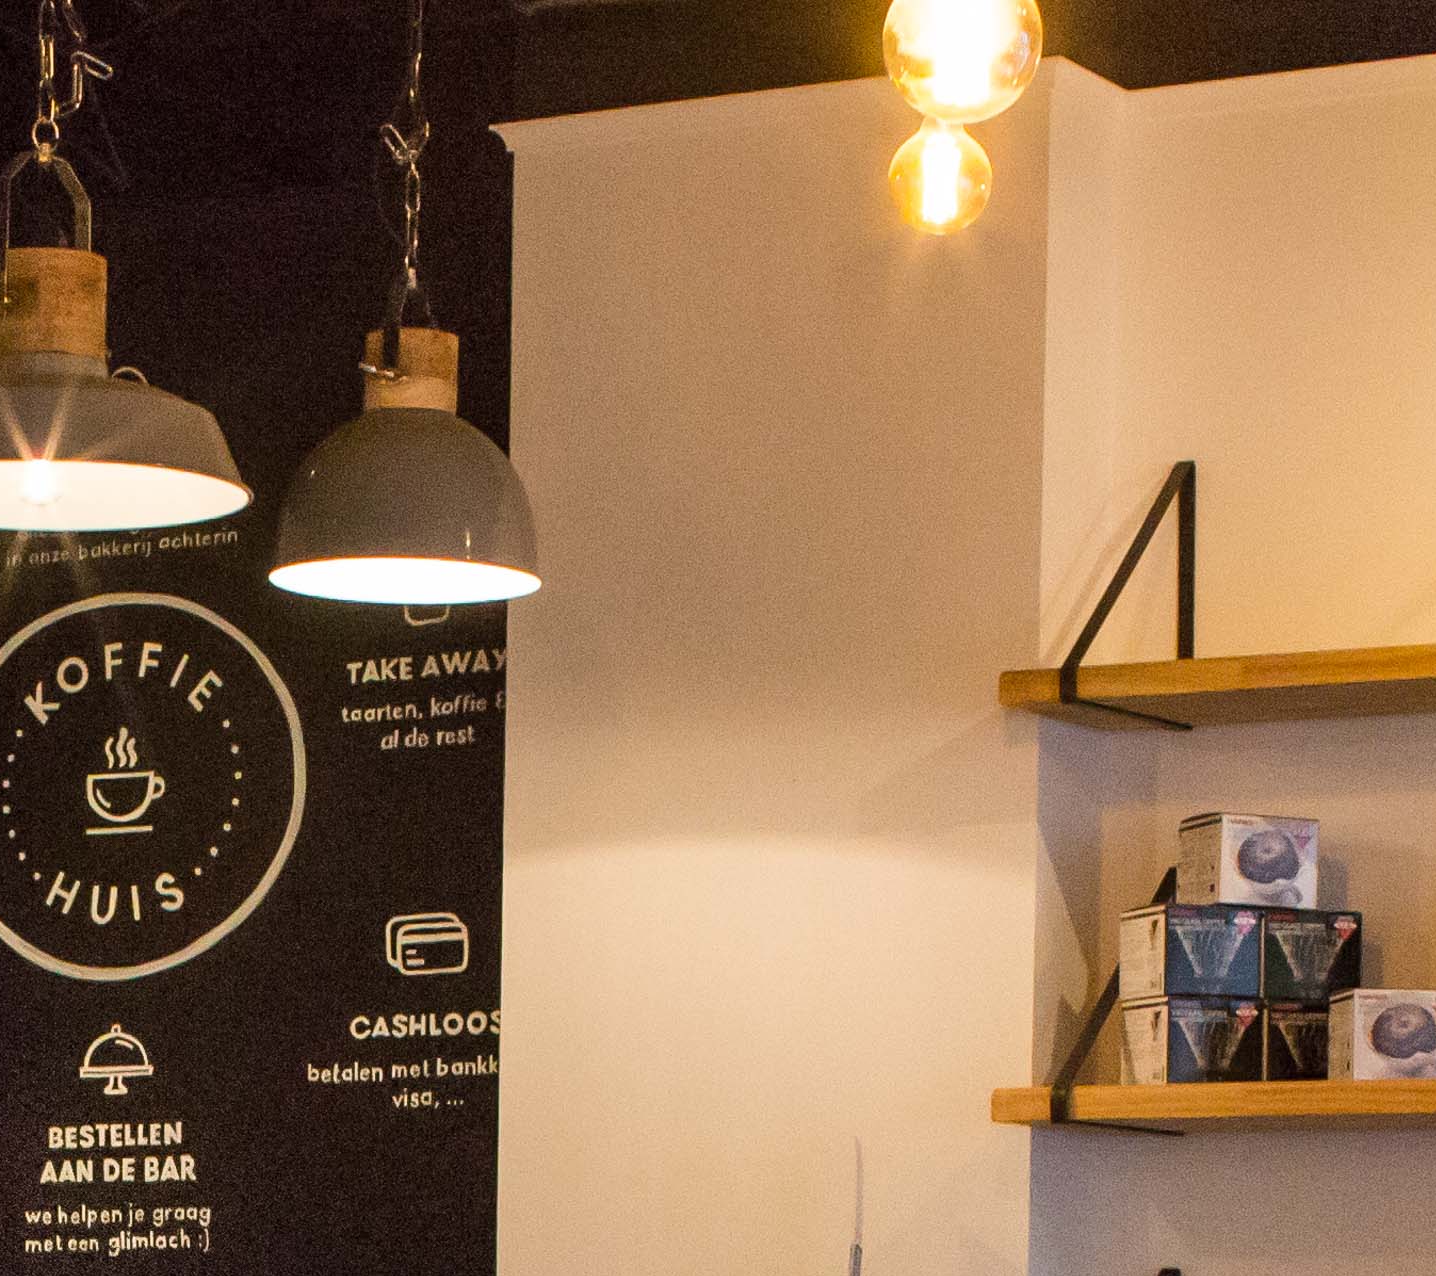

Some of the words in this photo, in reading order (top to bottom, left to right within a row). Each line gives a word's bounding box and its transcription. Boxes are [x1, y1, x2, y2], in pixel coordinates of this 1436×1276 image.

[78, 539, 152, 560] bakkerij
[159, 527, 239, 549] achterin
[24, 642, 224, 725] KOFFIE
[346, 656, 413, 685] TAKE
[341, 702, 424, 723] taarten,
[430, 692, 487, 717] koffie
[380, 729, 399, 750] al
[436, 725, 474, 746] rest
[46, 871, 184, 925] HUIS
[307, 1062, 383, 1084] betalen
[391, 1059, 430, 1079] met
[391, 1088, 440, 1109] visa,
[48, 1121, 183, 1149] BESTELLEN
[40, 1159, 94, 1184] AAN
[103, 1157, 135, 1183] DE
[144, 1154, 197, 1183] BAR
[25, 1209, 52, 1225] we
[57, 1204, 123, 1229] helpen
[128, 1202, 145, 1227] je
[153, 1206, 211, 1227] graag
[25, 1235, 63, 1252] met
[67, 1238, 100, 1252] een
[108, 1228, 191, 1257] glimlach
